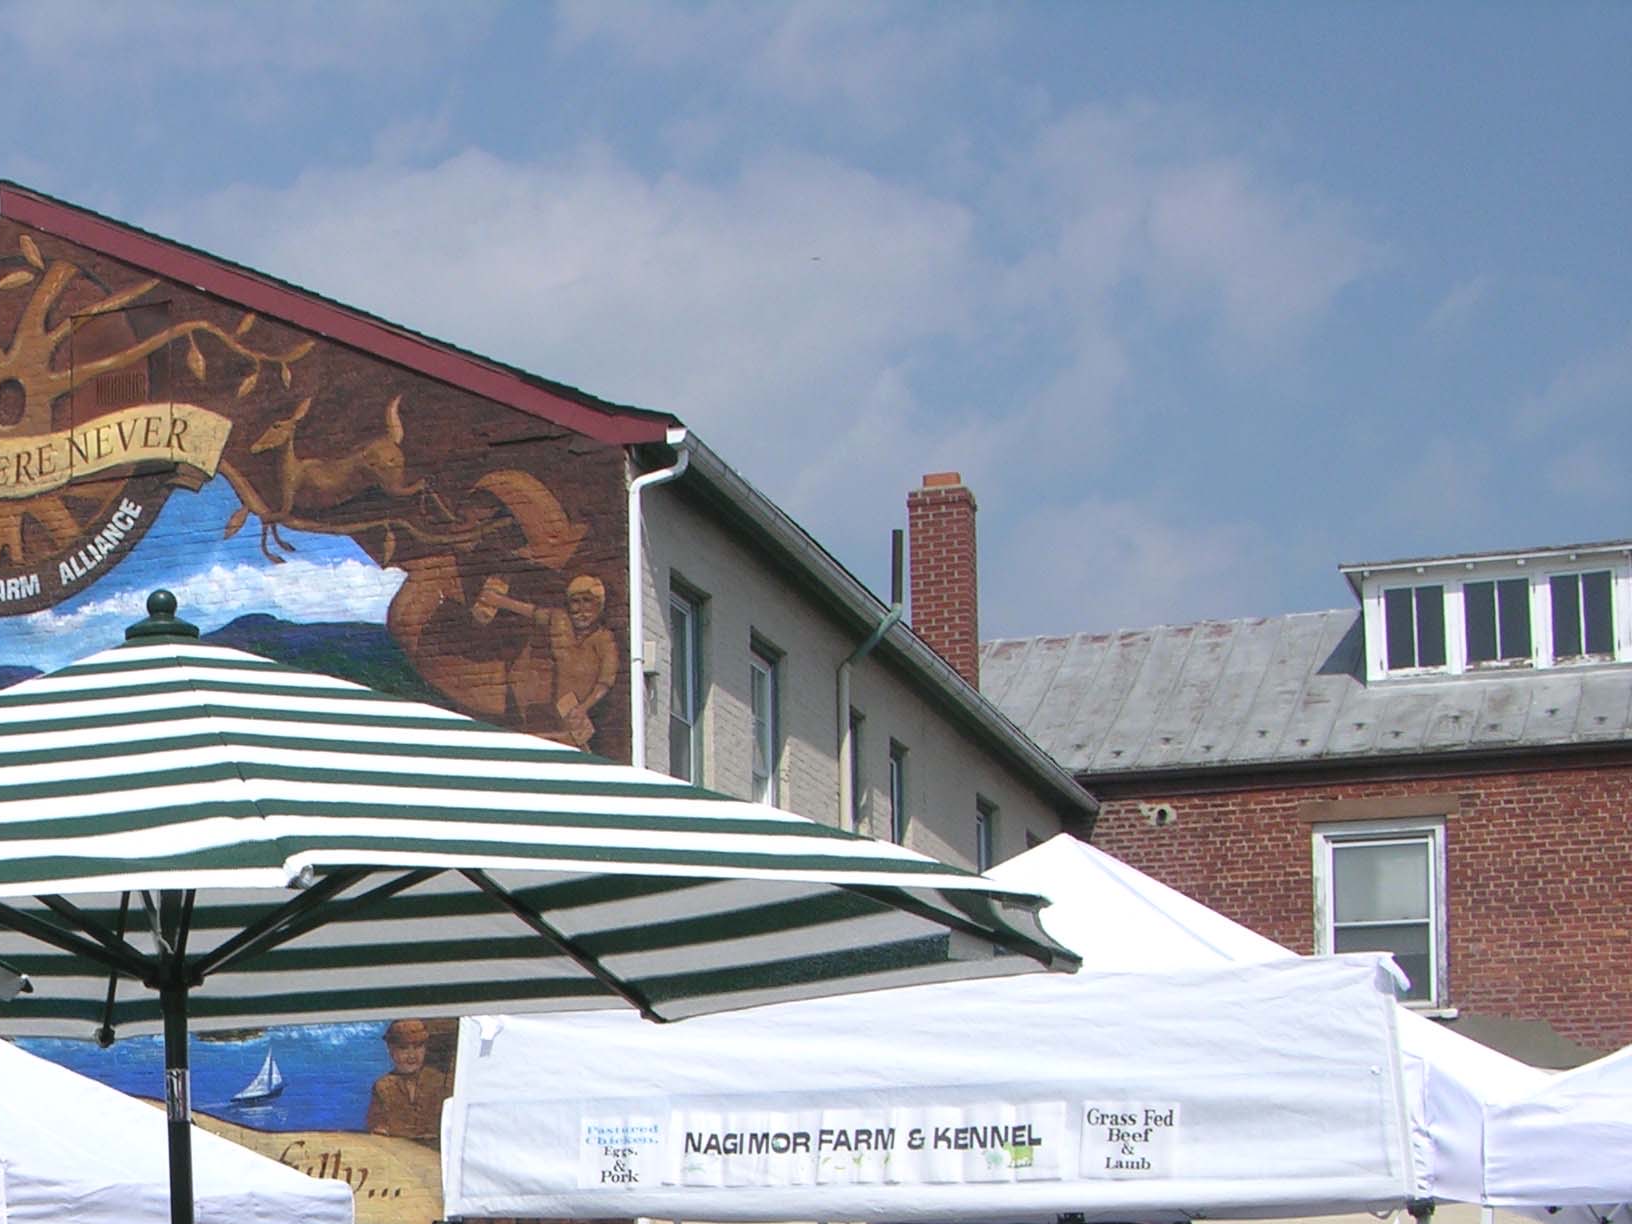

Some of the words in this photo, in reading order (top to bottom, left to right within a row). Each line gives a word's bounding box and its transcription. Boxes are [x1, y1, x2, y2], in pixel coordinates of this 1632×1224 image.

[66, 416, 189, 468] NEVER
[58, 497, 142, 585] ALLIANCE
[1087, 1107, 1137, 1126] Grass
[1143, 1108, 1174, 1127] Fed
[818, 1128, 896, 1152] FARM
[907, 1128, 925, 1150] &
[933, 1124, 1042, 1149] KENNEL
[1107, 1127, 1153, 1142] Beef
[1121, 1143, 1134, 1155] &
[613, 1159, 626, 1172] &
[1106, 1157, 1151, 1170] Lamb
[600, 1169, 639, 1183] Pork
